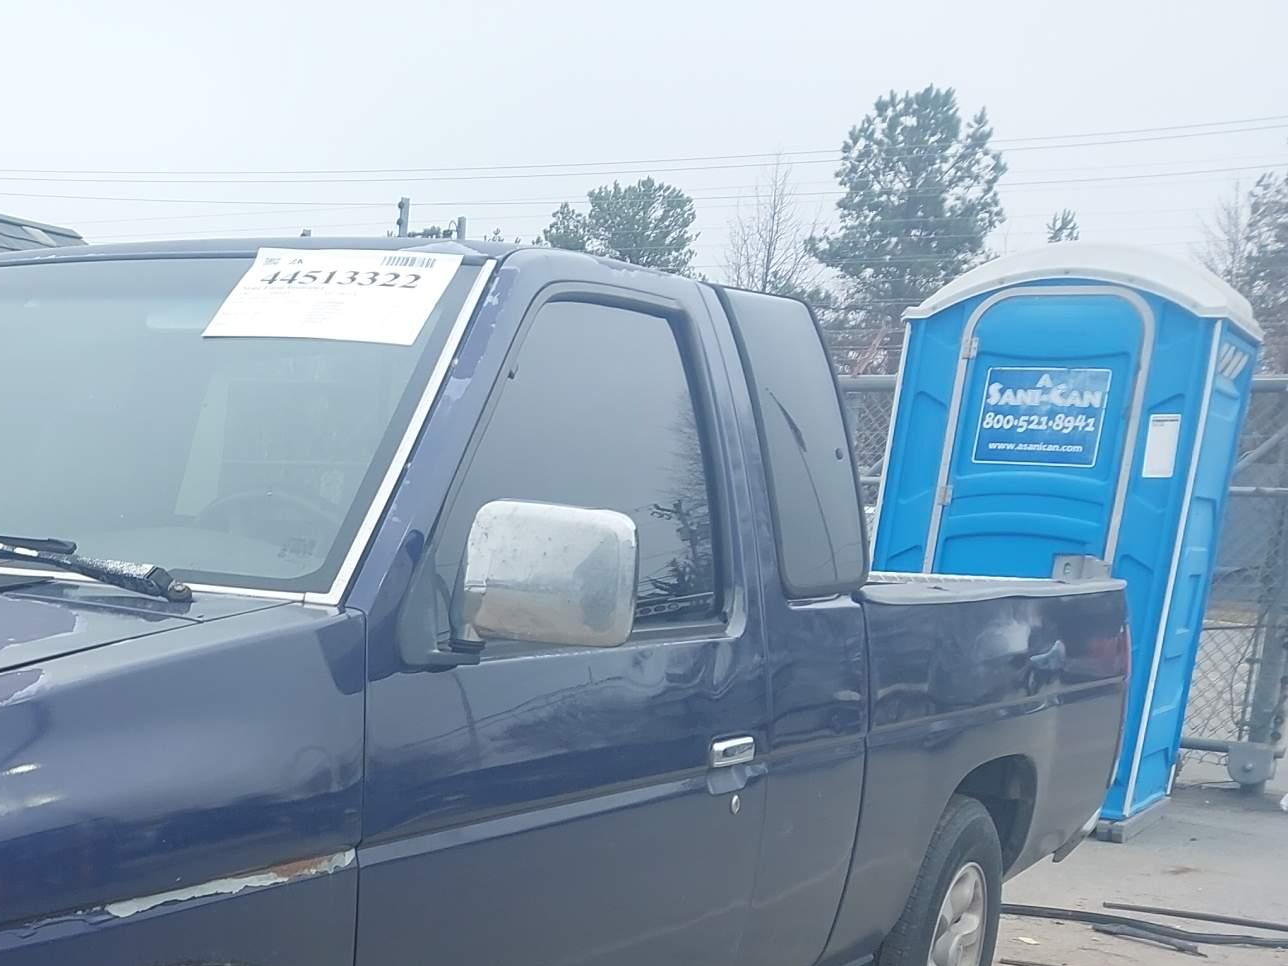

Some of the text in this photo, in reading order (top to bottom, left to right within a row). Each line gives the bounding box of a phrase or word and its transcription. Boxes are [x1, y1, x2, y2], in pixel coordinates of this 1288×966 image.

[260, 270, 422, 289] 44513322
[1036, 373, 1053, 388] A
[986, 382, 1104, 408] SANI-CAN
[988, 441, 1083, 453] www.asanican.com
